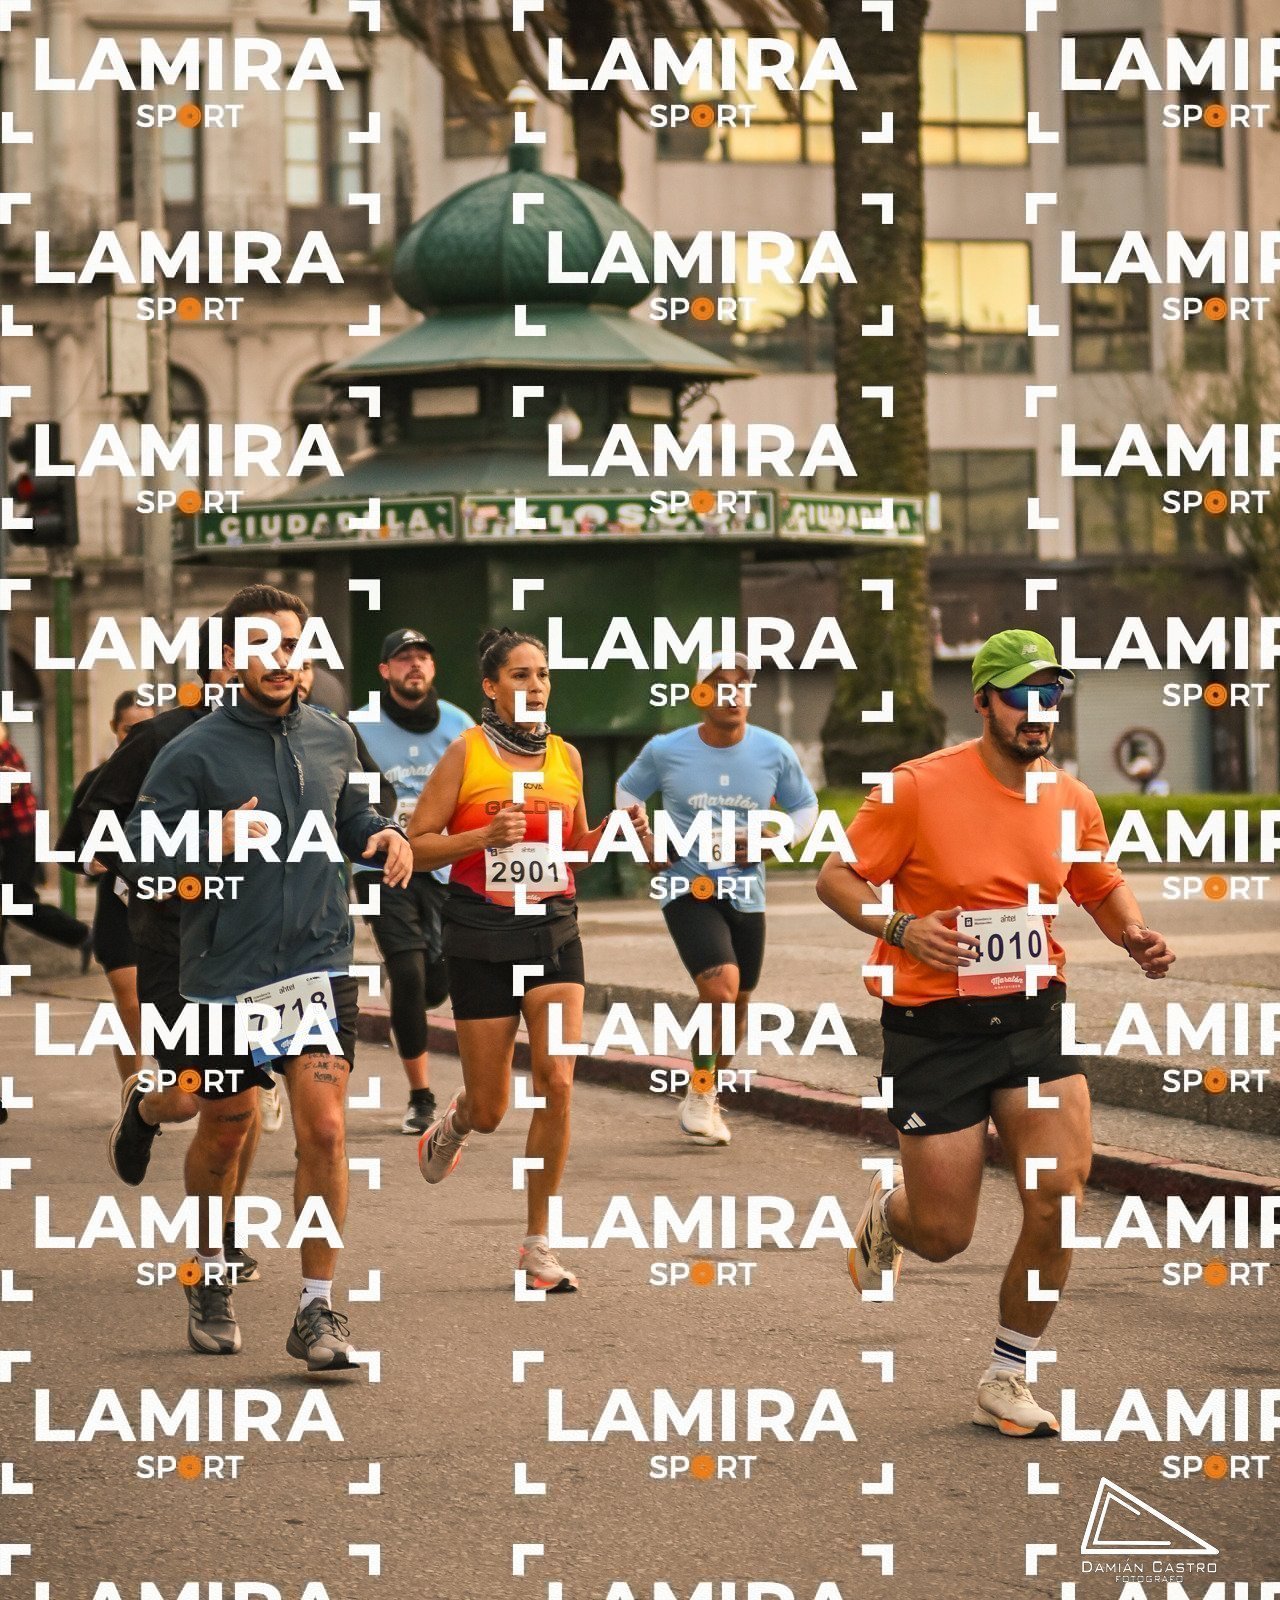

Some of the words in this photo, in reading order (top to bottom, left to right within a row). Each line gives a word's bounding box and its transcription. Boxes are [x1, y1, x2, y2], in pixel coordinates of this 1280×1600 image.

[219, 508, 434, 538] CIUDADLA
[491, 860, 559, 883] 2901
[967, 929, 1042, 963] 4010
